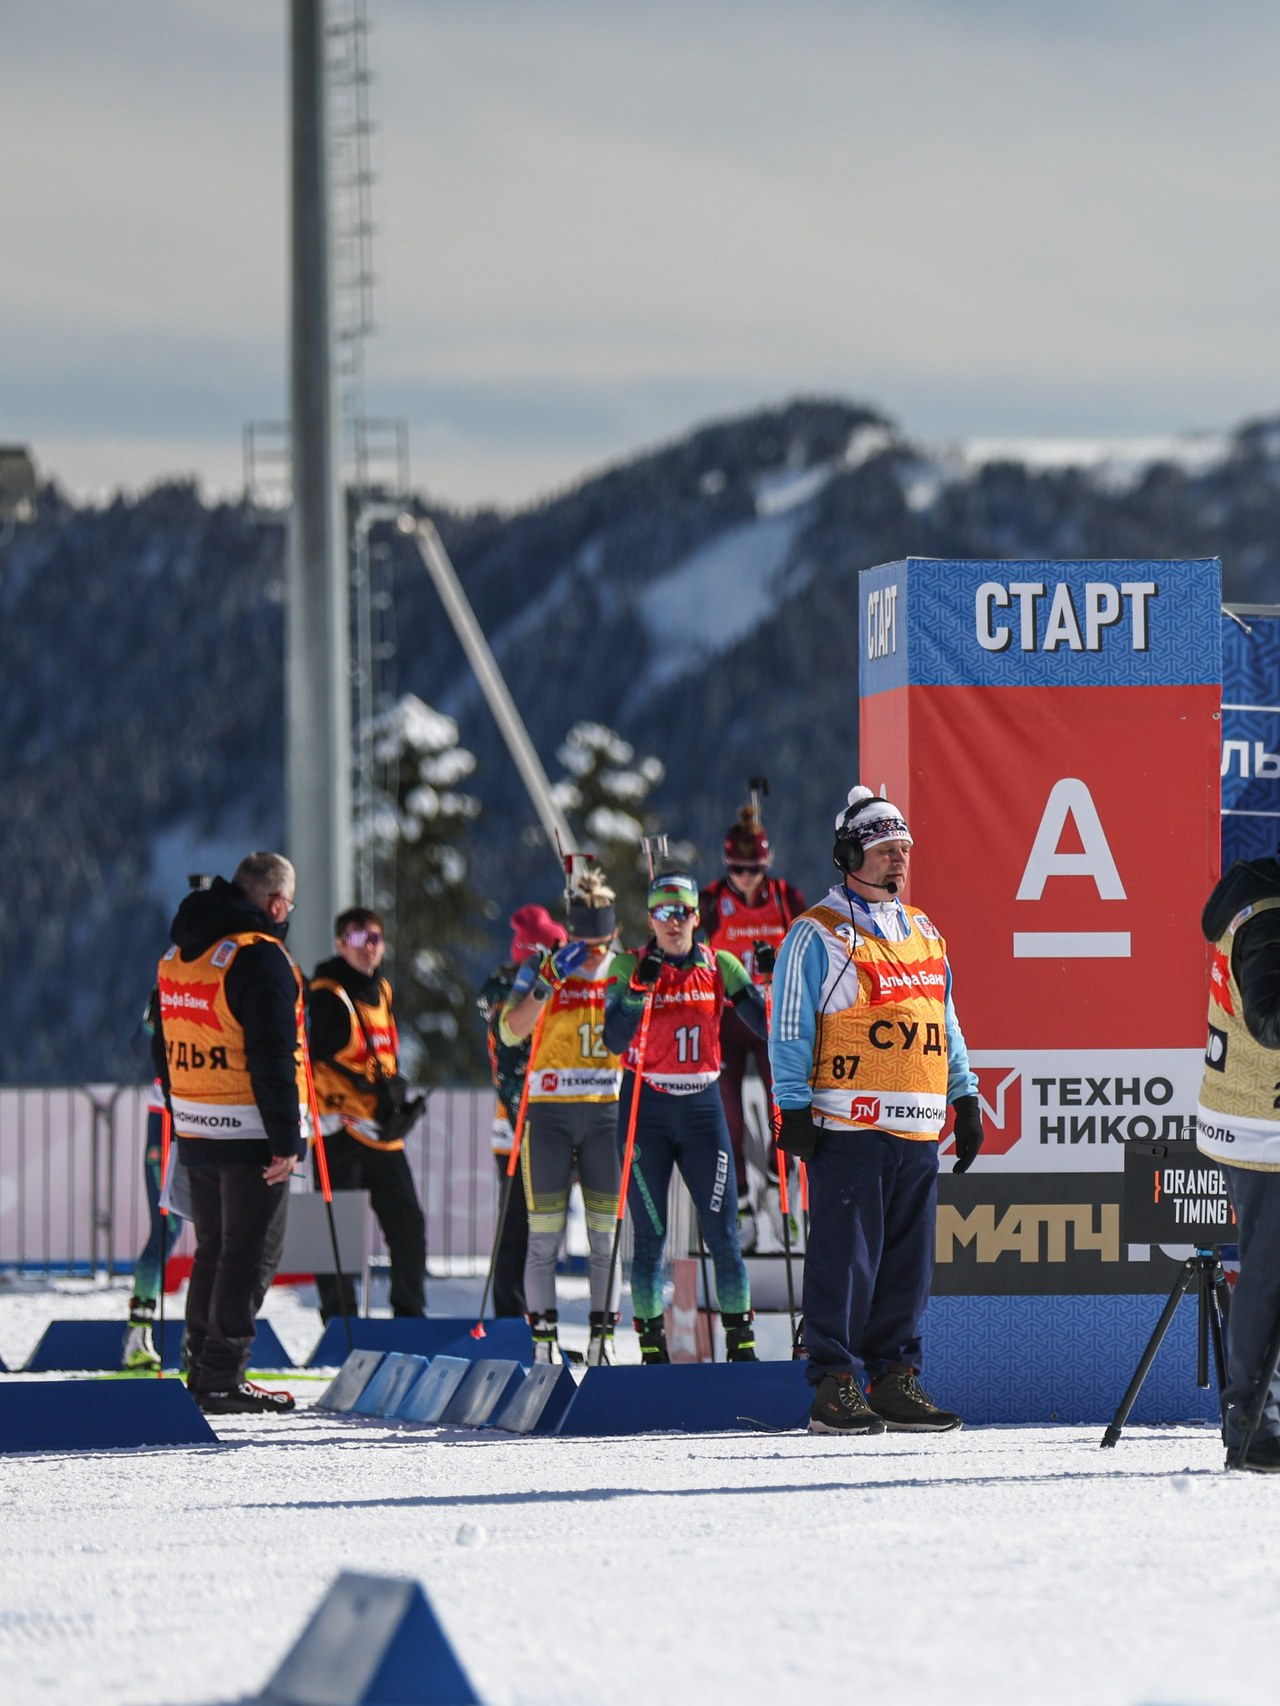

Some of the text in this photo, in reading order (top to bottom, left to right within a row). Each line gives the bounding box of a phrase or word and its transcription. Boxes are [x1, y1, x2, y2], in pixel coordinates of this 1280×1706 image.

[867, 585, 898, 661] СТАРТ
[975, 582, 1156, 651] СТАРТ
[880, 971, 944, 992] Альфа Банк
[184, 992, 210, 1011] Банк
[655, 990, 716, 1006] Альфа Банк
[578, 1023, 609, 1059] 12
[675, 1025, 700, 1063] 11
[869, 1021, 946, 1056] СУД
[832, 1055, 861, 1080] 87
[1032, 1077, 1174, 1106] ТЕХНО
[1164, 1170, 1227, 1195] ORANGE
[1173, 1199, 1228, 1224] TIMING
